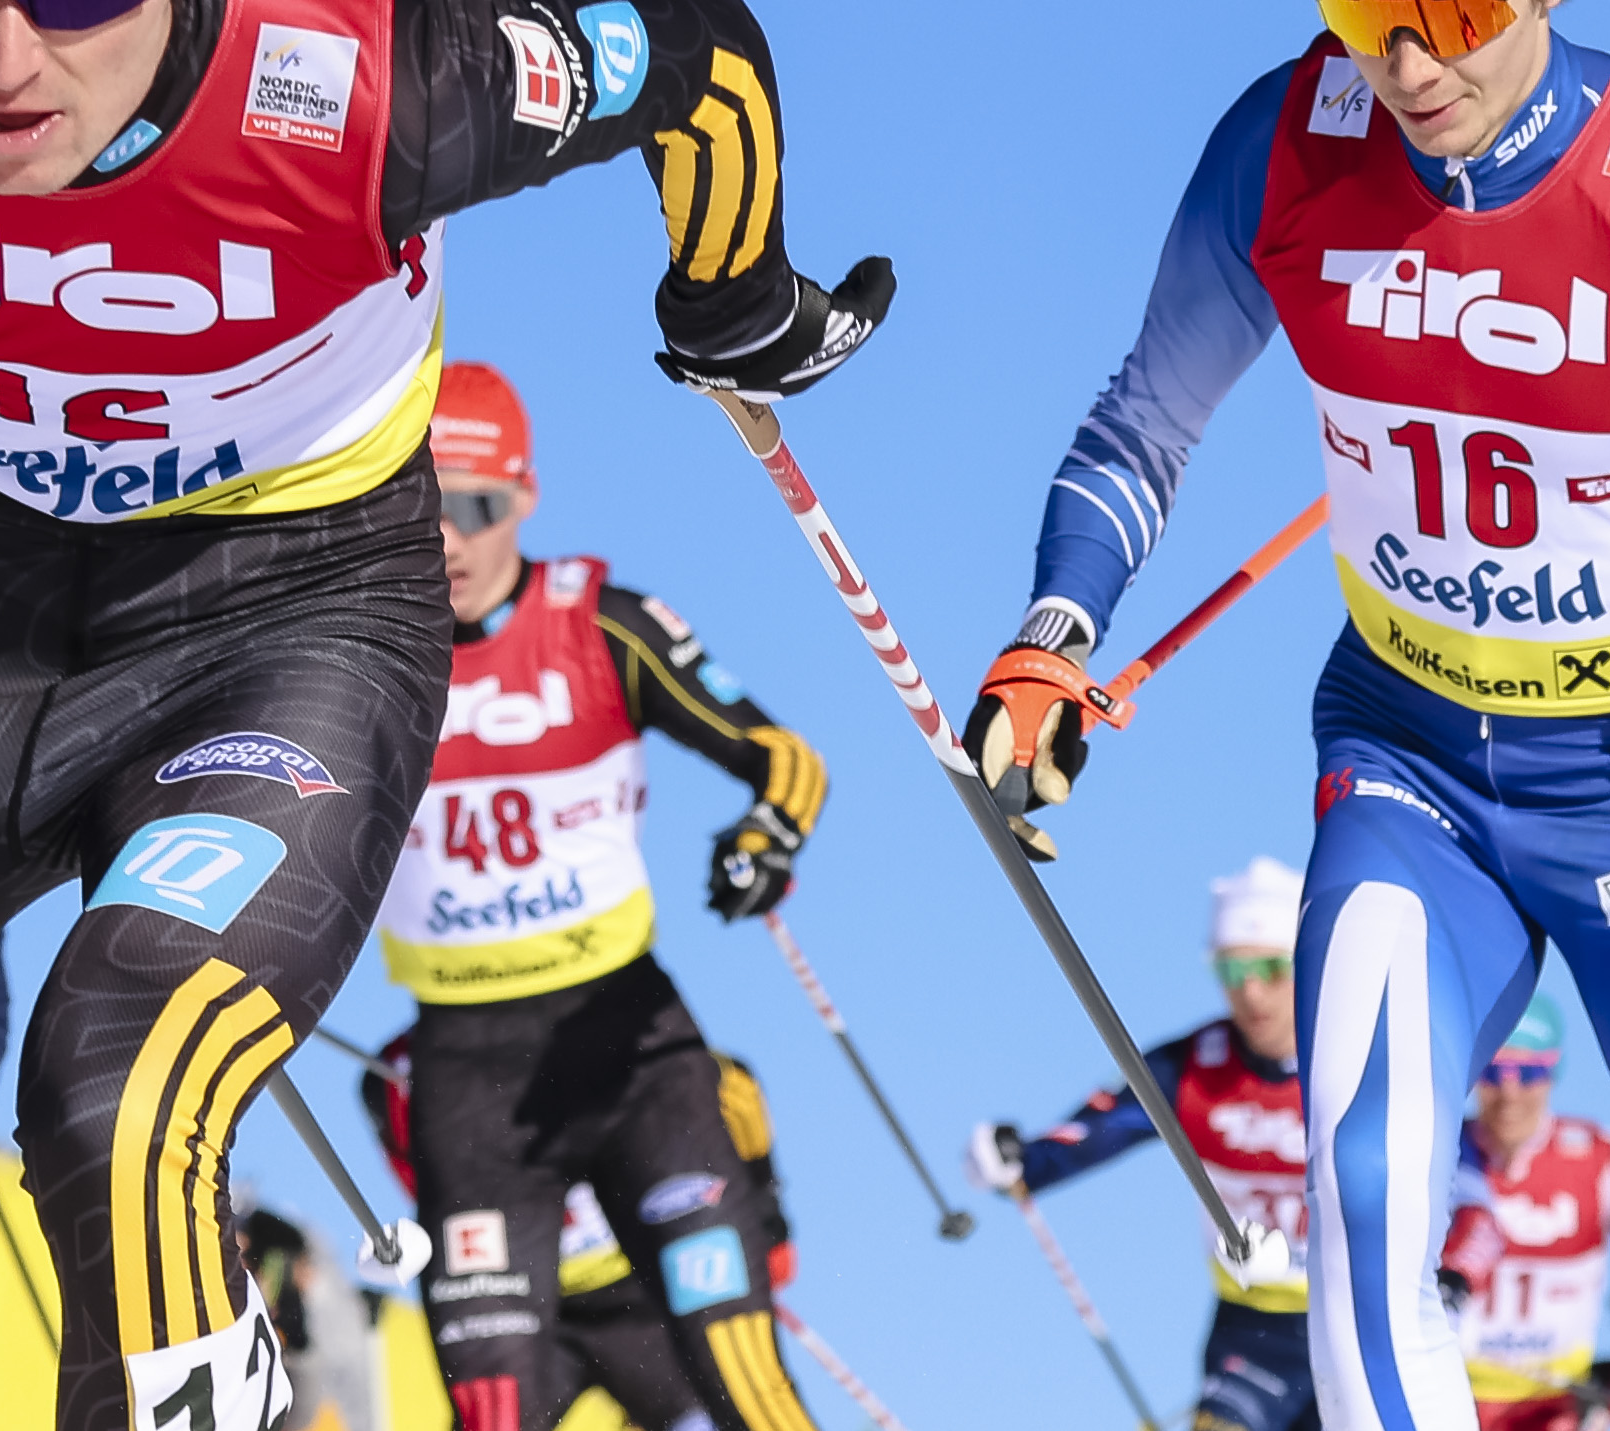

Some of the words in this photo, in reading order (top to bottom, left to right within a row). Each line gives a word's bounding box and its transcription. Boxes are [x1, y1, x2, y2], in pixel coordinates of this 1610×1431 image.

[254, 99, 300, 116] WORLD
[302, 106, 327, 122] CUP
[256, 89, 340, 115] COMBINED
[259, 75, 321, 95] NORDIC
[252, 116, 336, 144] VIESSMANN
[1320, 248, 1609, 375] Tirol
[1387, 420, 1539, 549] 16
[1369, 531, 1606, 629] Seefeld
[1387, 618, 1547, 699] Raiffeisen
[167, 730, 318, 775] personal
[188, 747, 271, 771] shop
[443, 788, 540, 873] 48
[427, 868, 585, 935] Seefeld
